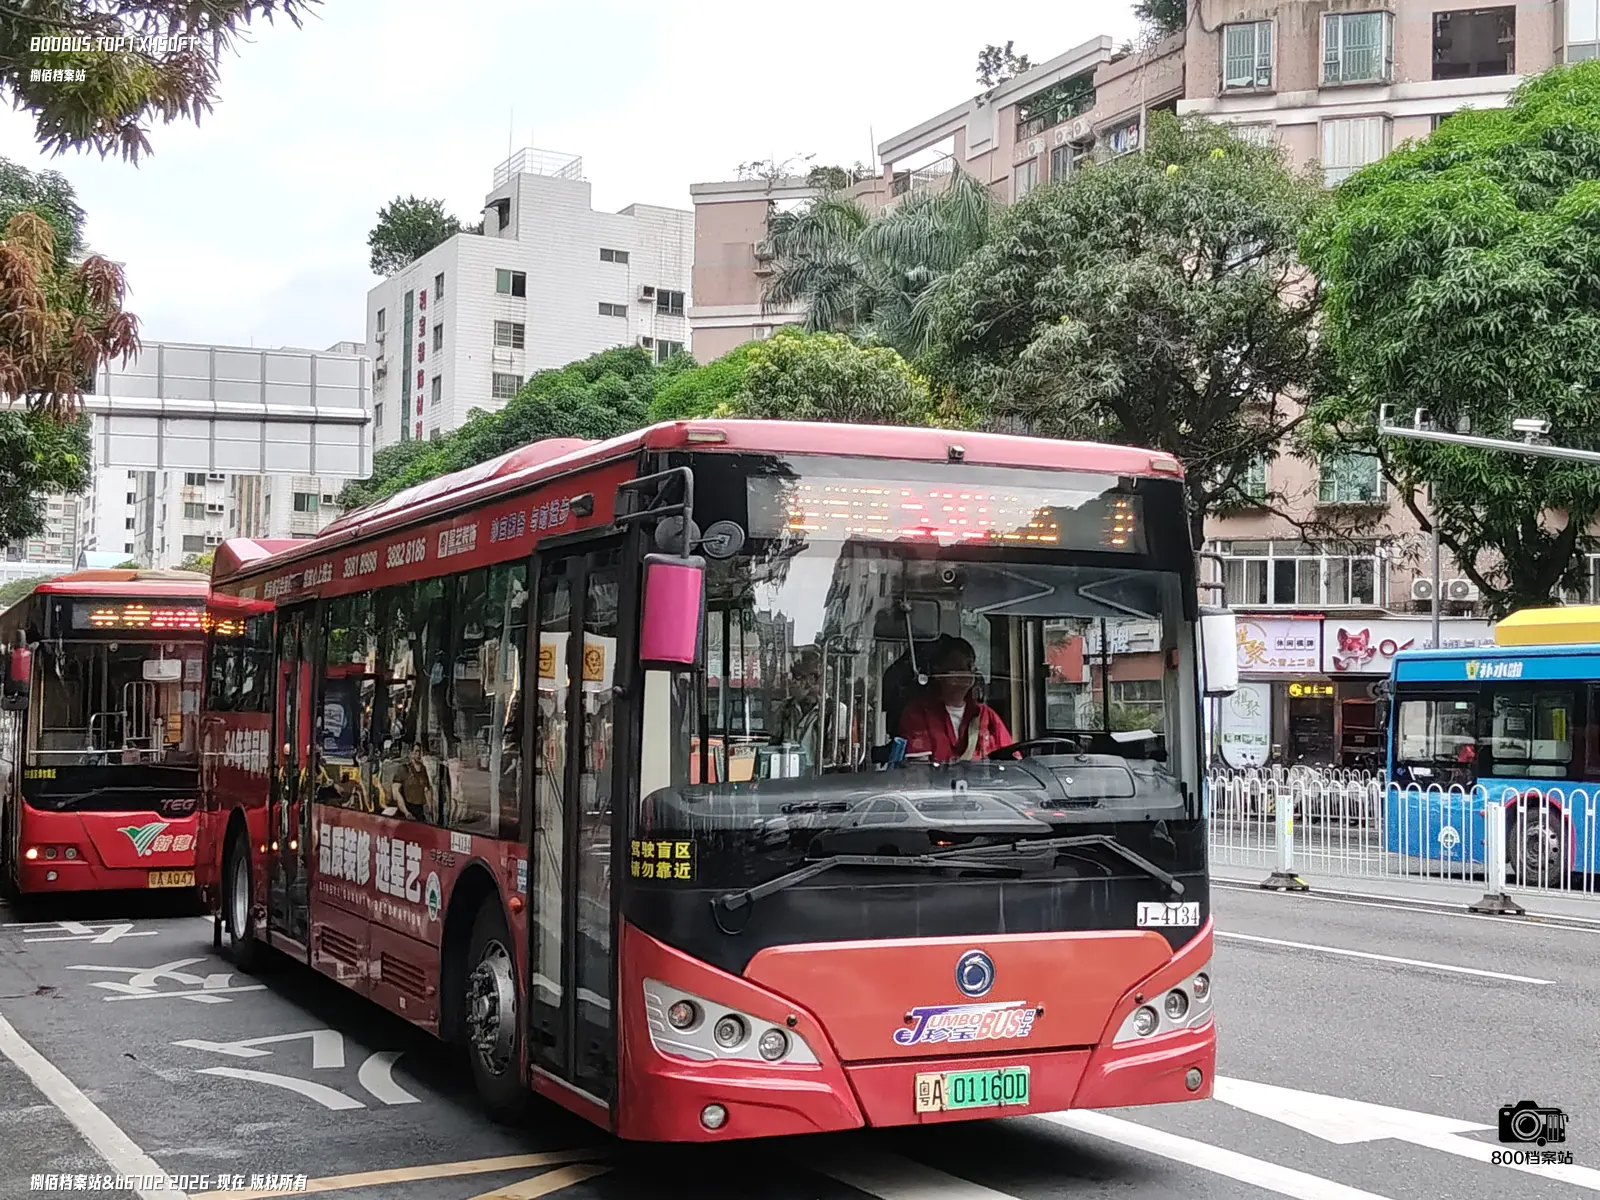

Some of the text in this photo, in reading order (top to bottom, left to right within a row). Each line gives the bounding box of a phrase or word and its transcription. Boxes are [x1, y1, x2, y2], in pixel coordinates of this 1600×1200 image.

[1479, 661, 1524, 678] 补水啦
[160, 799, 196, 811] TEG
[153, 834, 197, 852] 新穗
[631, 840, 691, 859] 驾驶盲区
[319, 823, 370, 886] 品质装修
[375, 835, 422, 904] 选星艺
[631, 861, 691, 879] 请勿靠近
[1139, 905, 1198, 925] J-4134
[976, 1009, 1024, 1039] BUS
[922, 1026, 978, 1042] 珍宝
[953, 1073, 1027, 1104] 01160D
